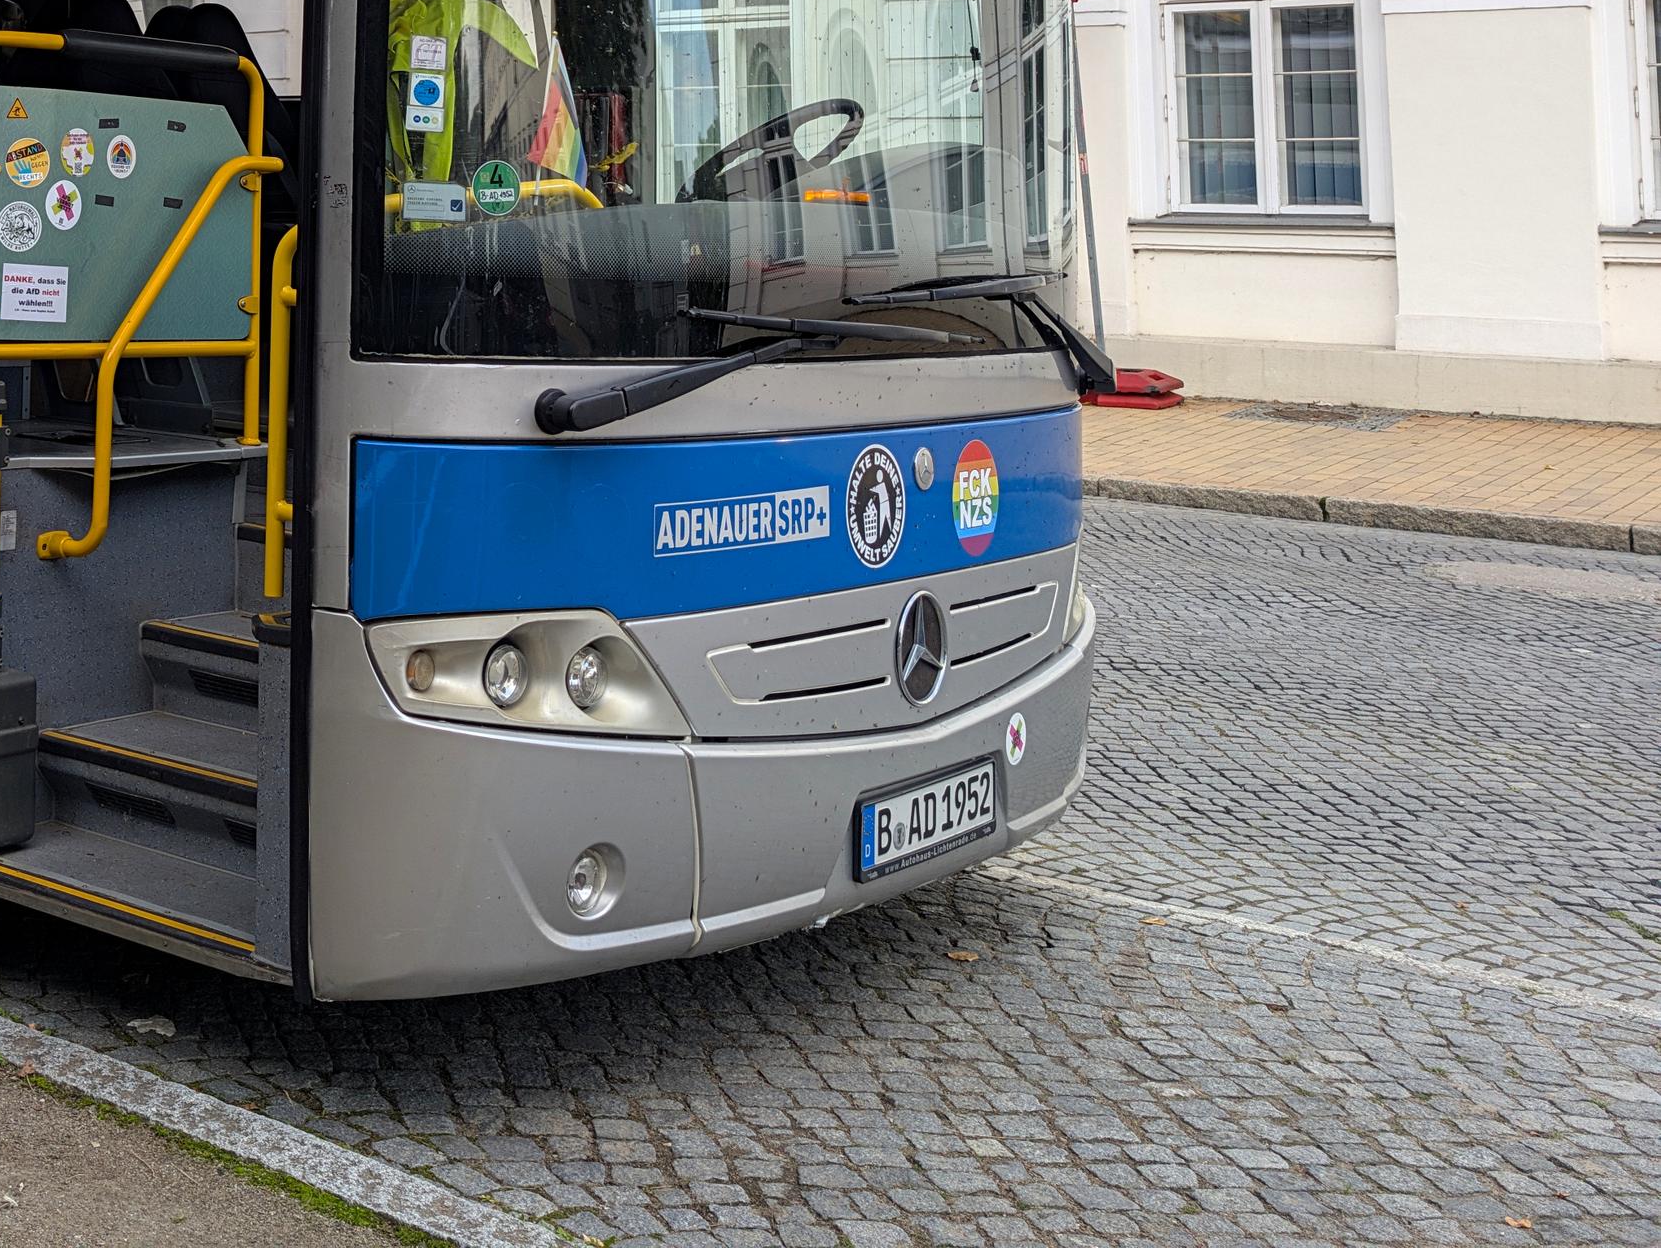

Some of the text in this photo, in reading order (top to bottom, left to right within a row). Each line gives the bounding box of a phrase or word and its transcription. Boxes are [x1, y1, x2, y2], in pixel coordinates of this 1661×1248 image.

[6, 143, 44, 162] ABSTAND
[490, 164, 504, 188] 4
[4, 275, 67, 286] DANKE, dass Sie
[11, 287, 61, 297] die AfD nicht
[18, 300, 54, 308] wählen!!!
[849, 452, 901, 505] HALTE DEINE
[958, 467, 993, 500] FCK
[656, 497, 827, 550] ADENAUER SRP+
[849, 496, 903, 563] UMWELT SAUBER
[959, 497, 994, 530] NZS
[877, 771, 991, 856] B AD 1952
[865, 844, 871, 858] D
[884, 832, 978, 874] www.Autohaus-Lichtenrade.de
